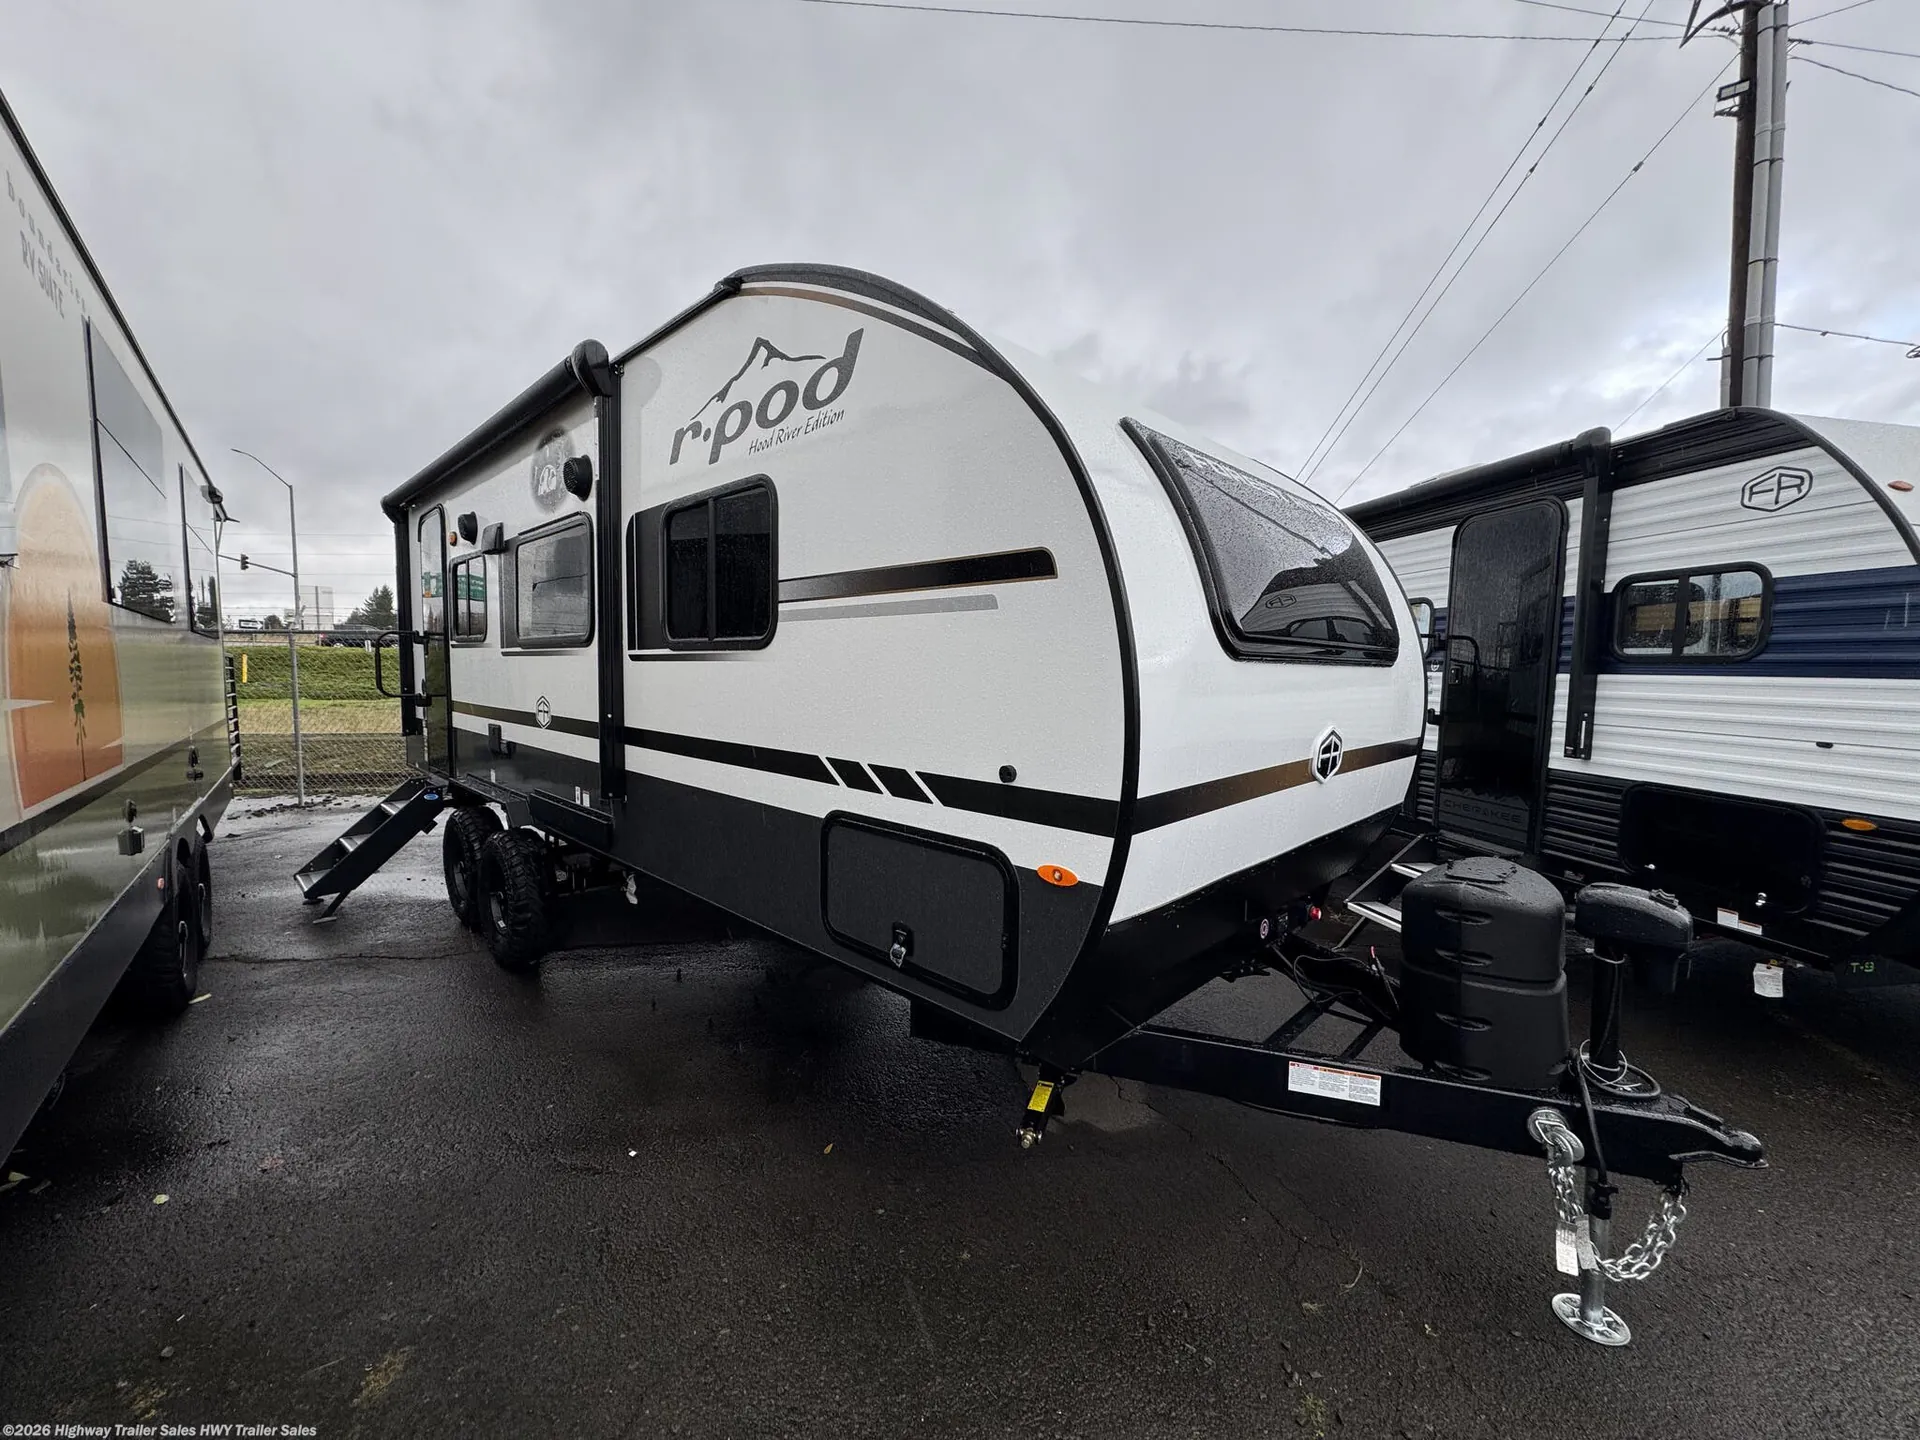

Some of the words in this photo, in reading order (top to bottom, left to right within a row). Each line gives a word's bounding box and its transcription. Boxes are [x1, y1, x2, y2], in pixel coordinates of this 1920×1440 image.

[20, 229, 36, 278] RV
[748, 435, 775, 455] Hood
[775, 425, 803, 446] River
[804, 408, 846, 436] Edition
